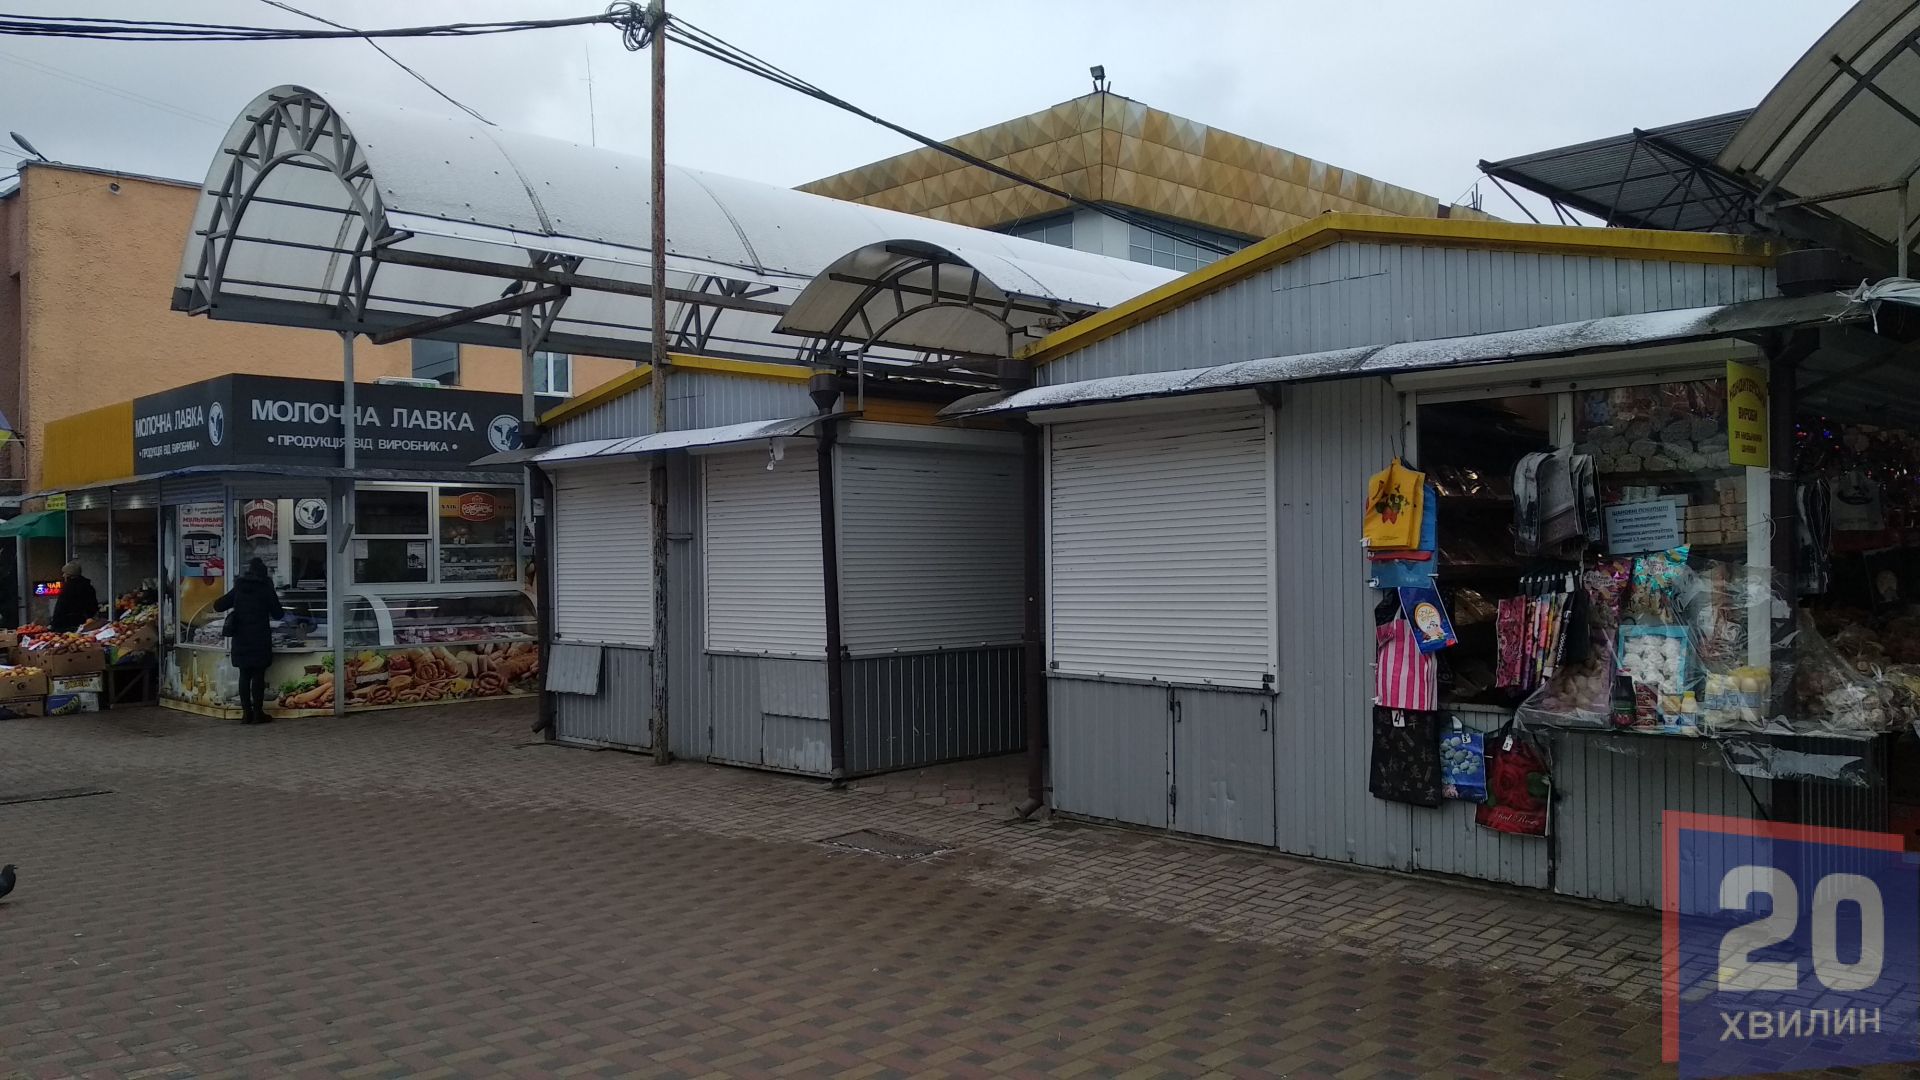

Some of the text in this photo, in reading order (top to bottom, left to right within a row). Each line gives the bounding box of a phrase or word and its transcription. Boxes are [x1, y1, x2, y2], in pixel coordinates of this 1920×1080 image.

[135, 405, 204, 438] МОЛОЧНА ЛАВКА
[252, 399, 475, 432] МОЛОЧНА ЛАВКА
[142, 445, 163, 458] ПРОДУКЦІЯ
[172, 440, 197, 454] ВИРОБНИКА
[278, 435, 449, 452] ПРОДУКЦІЯ ВІД ВИРОБНИКА
[247, 514, 272, 530] Ферма
